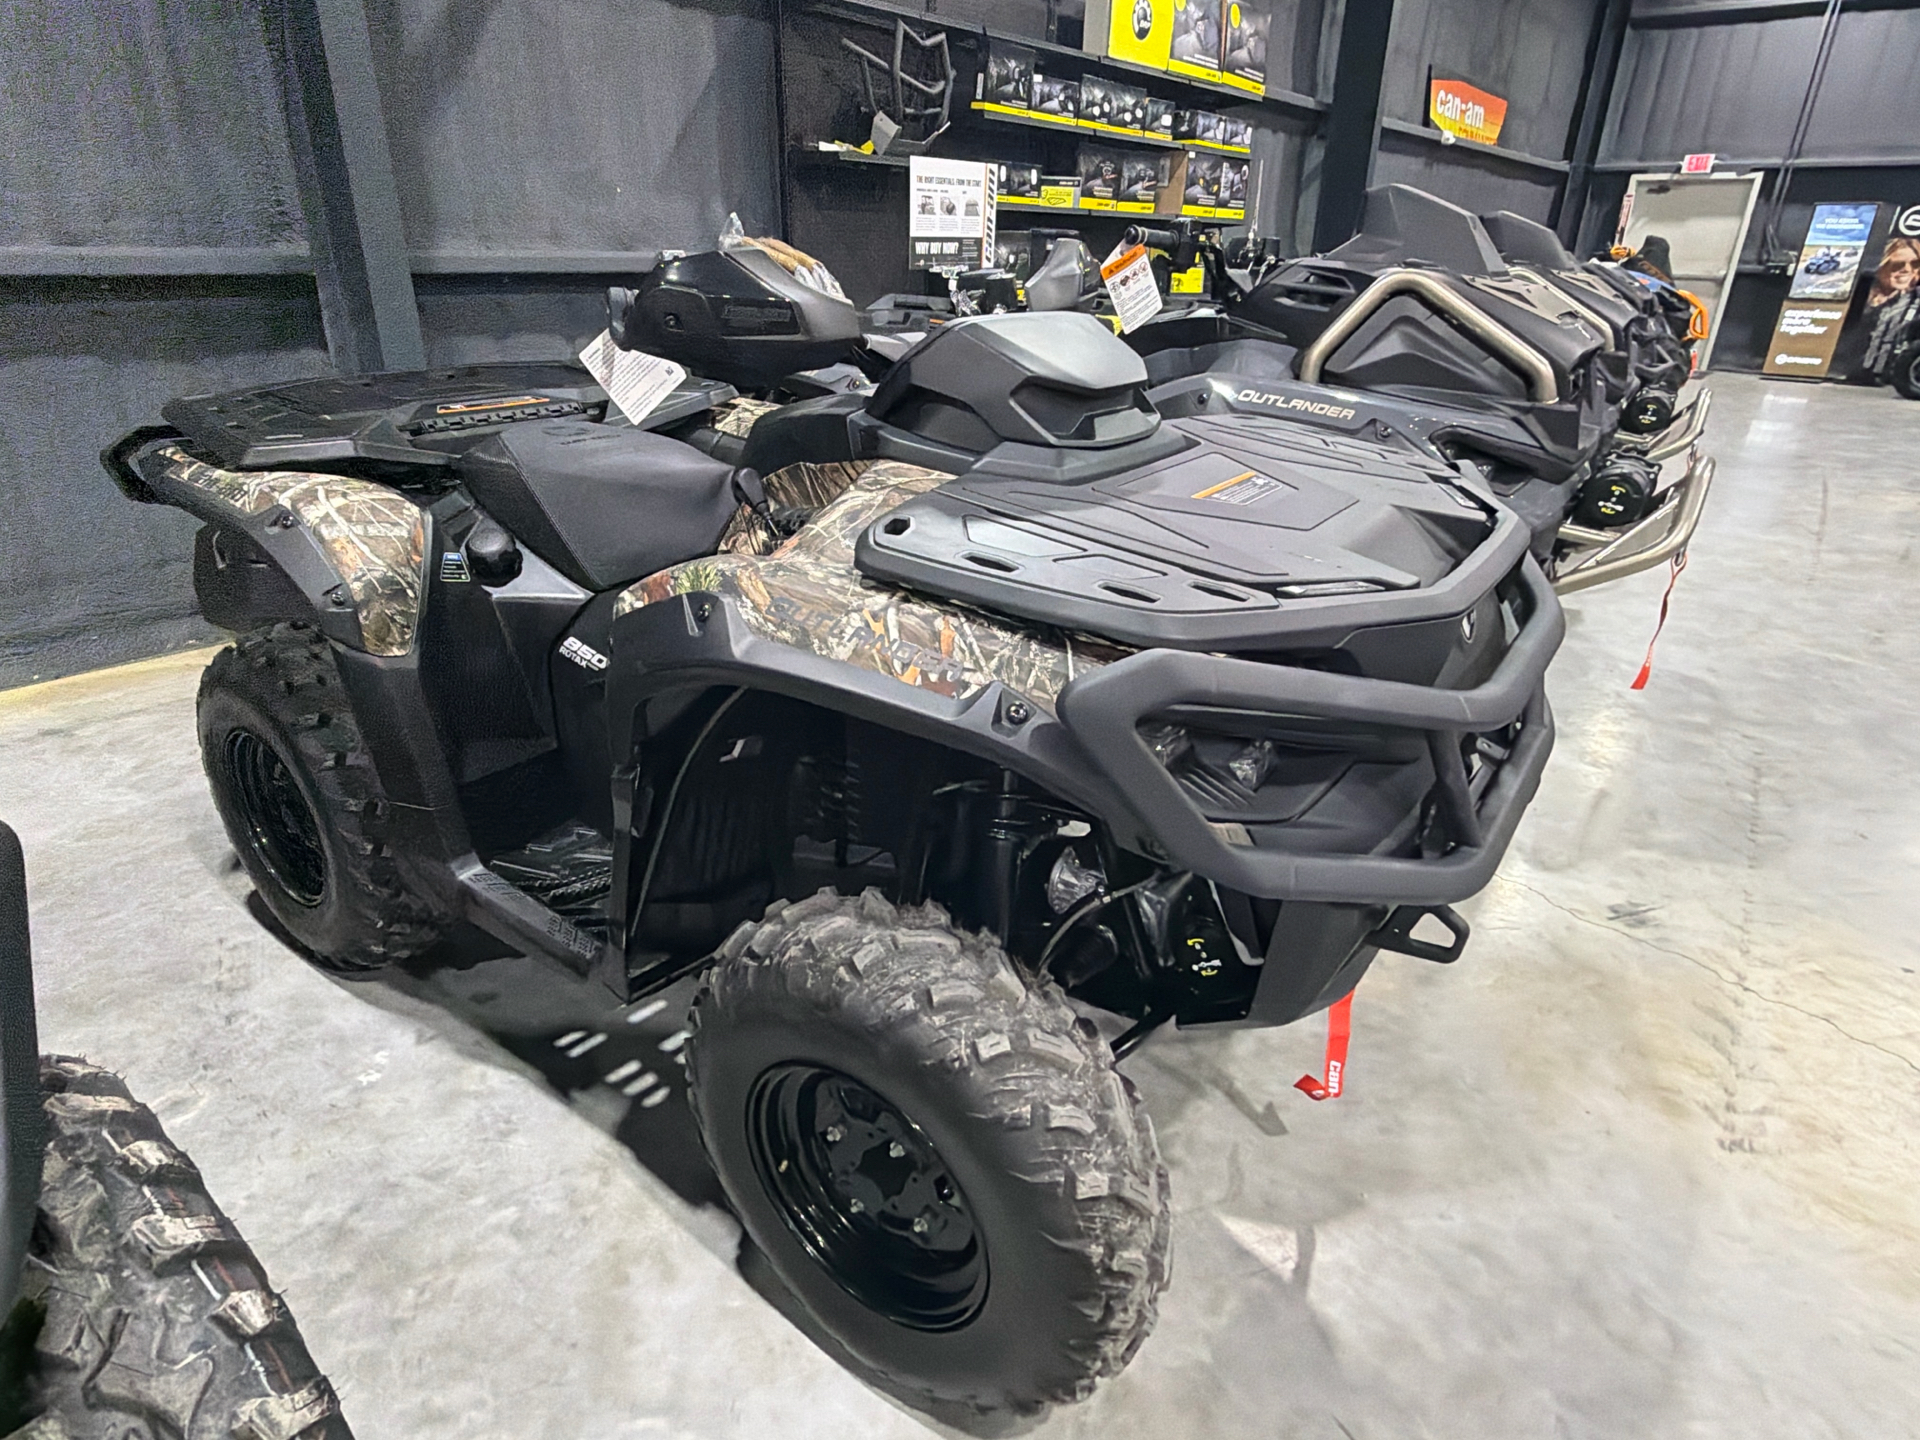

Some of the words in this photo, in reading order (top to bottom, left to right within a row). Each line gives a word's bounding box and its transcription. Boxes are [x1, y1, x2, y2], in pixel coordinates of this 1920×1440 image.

[1436, 89, 1485, 129] can-am
[1686, 155, 1711, 172] EXIT
[915, 242, 929, 254] WHY
[930, 242, 942, 254] BUY
[942, 242, 959, 254] NOW?
[1237, 389, 1356, 420] OUTLANDER
[563, 636, 608, 669] 850
[765, 597, 964, 683] OUTLANDER
[559, 645, 588, 669] ROTAX
